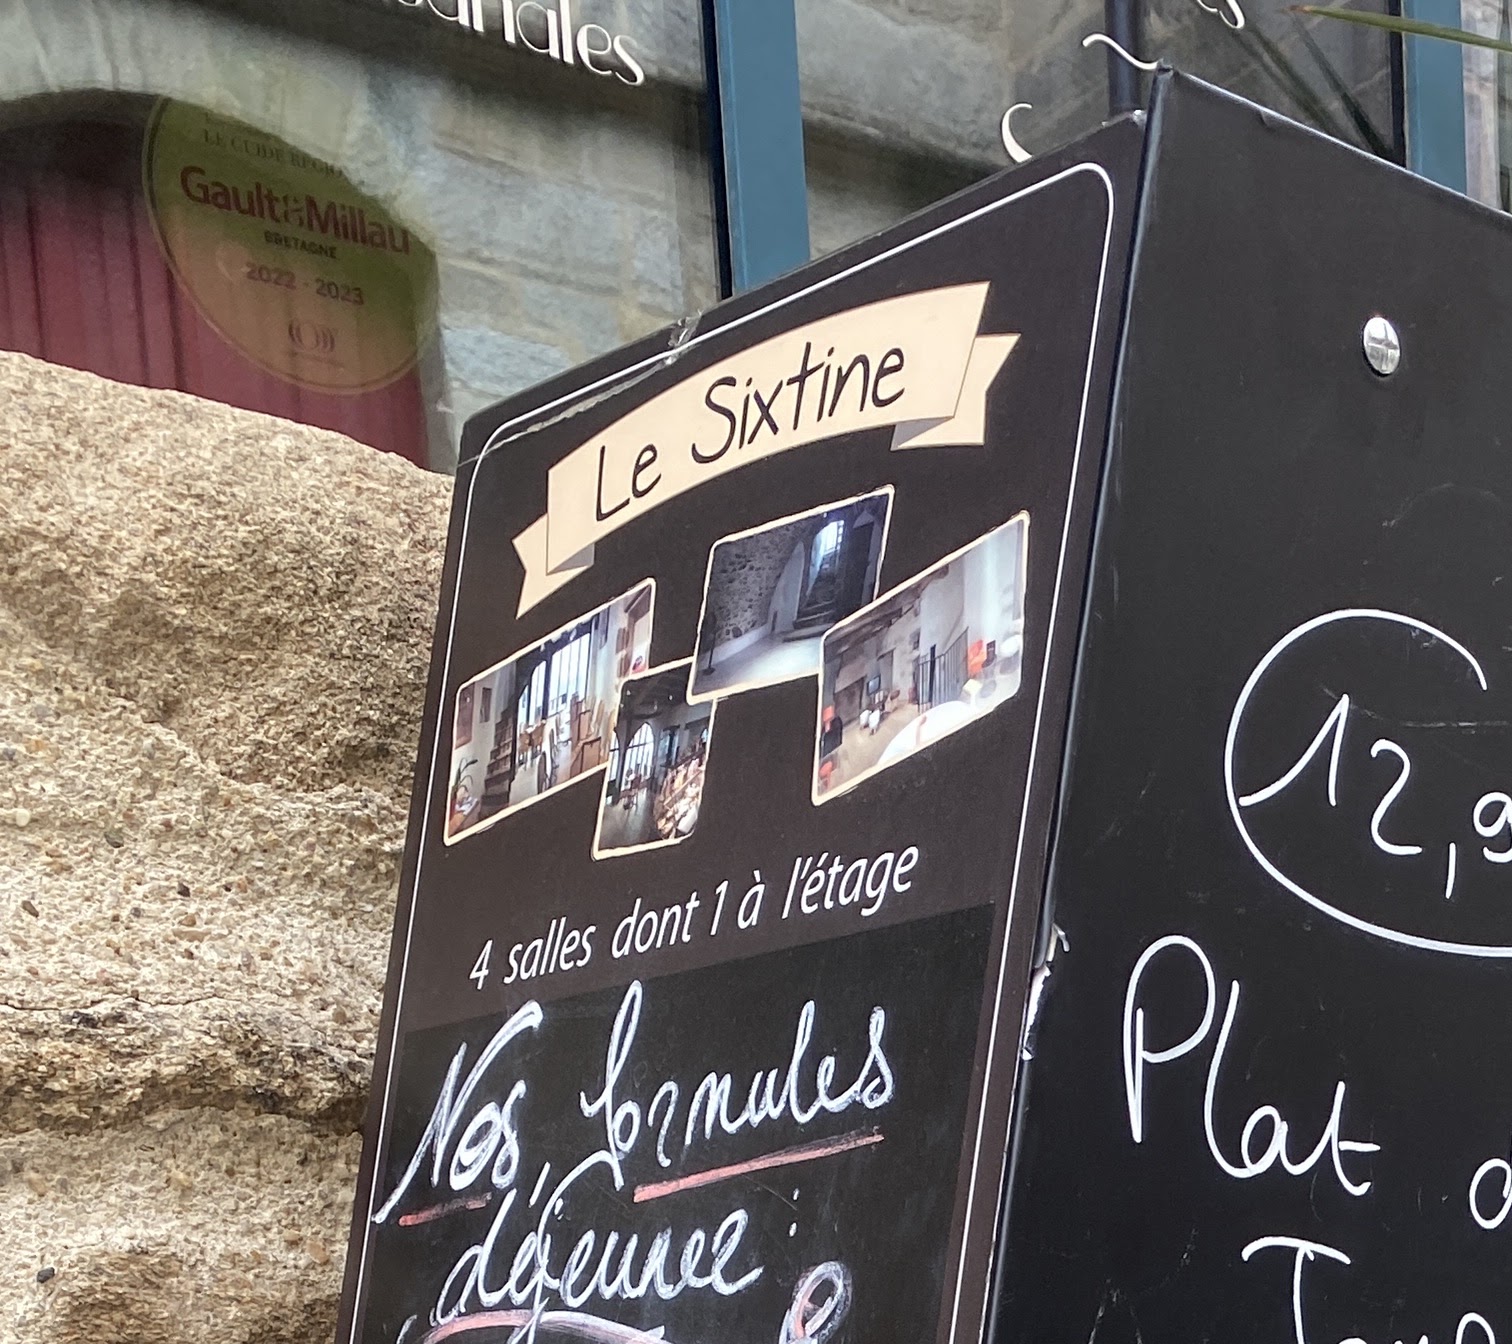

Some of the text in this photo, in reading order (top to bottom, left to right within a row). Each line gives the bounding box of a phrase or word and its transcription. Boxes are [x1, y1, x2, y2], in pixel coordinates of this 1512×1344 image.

[246, 261, 365, 306] 2022 2023
[263, 230, 338, 259] BRETAGNE
[596, 340, 906, 523] Le Sixtine
[469, 843, 920, 990] 4 salles dont 1 à l'étage
[371, 979, 895, 1225] Nos formules
[1122, 934, 1381, 1196] Plat
